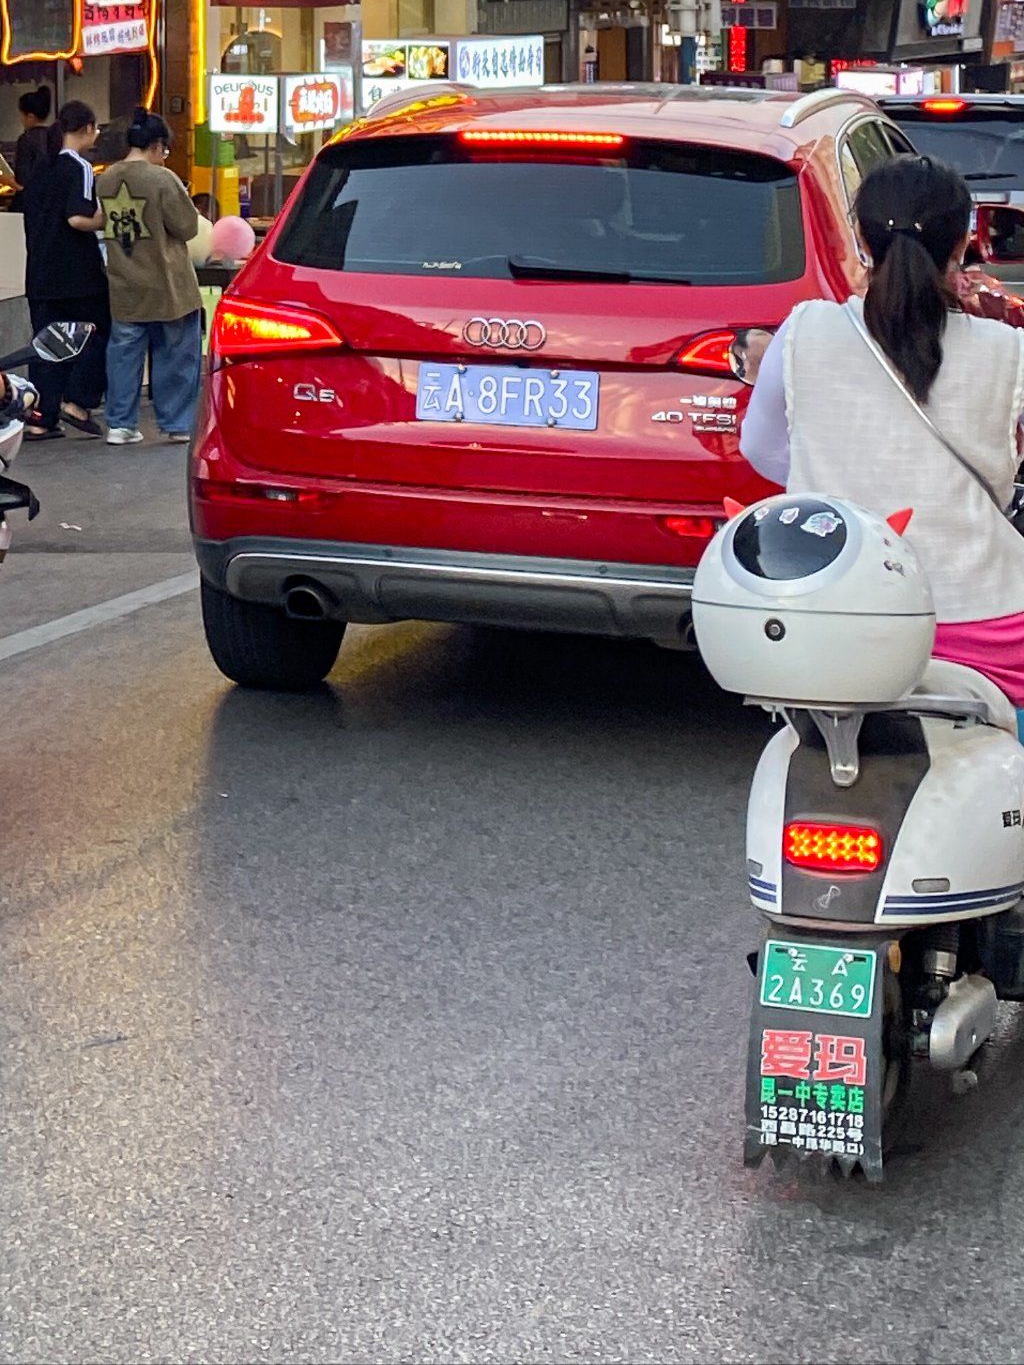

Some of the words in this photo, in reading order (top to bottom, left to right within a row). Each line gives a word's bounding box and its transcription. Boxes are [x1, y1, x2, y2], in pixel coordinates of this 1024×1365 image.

[293, 383, 335, 403] Q5
[650, 410, 684, 424] 40
[687, 411, 737, 427] TFSI
[791, 954, 809, 972] 云
[831, 958, 848, 977] A
[768, 975, 865, 1010] 2A369
[760, 1029, 867, 1086] 爱玛
[760, 1077, 864, 1114] 昆一中专卖店
[760, 1106, 864, 1128] 15287161718
